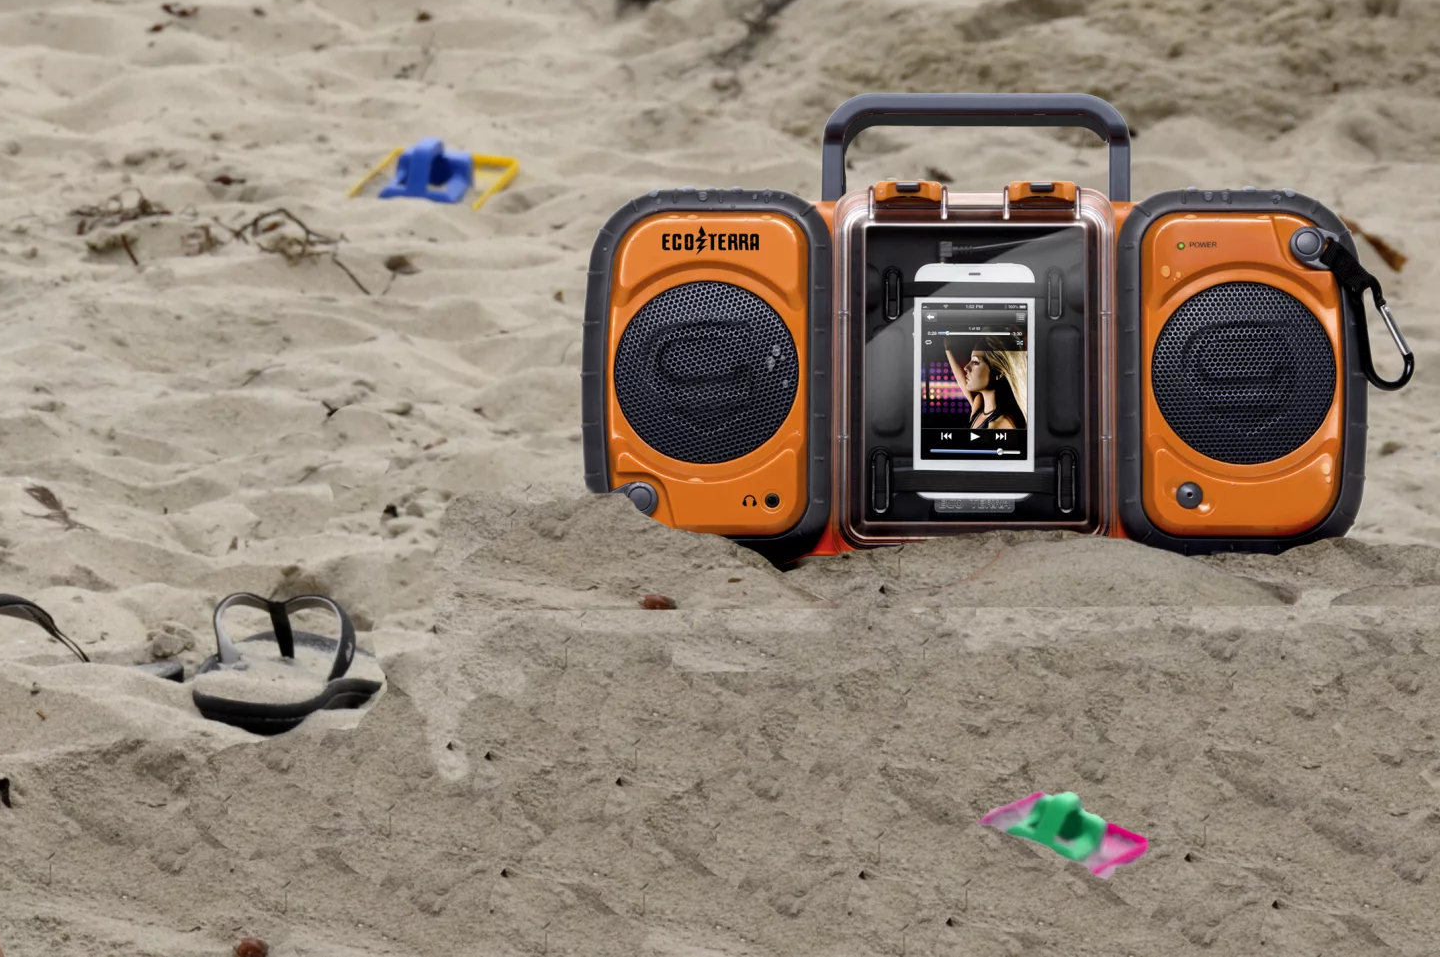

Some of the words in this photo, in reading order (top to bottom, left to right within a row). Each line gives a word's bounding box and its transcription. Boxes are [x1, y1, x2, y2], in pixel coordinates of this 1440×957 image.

[662, 233, 694, 251] ECO
[708, 233, 760, 251] TERRA
[938, 499, 963, 509] ECO
[969, 499, 1011, 509] TERRA
